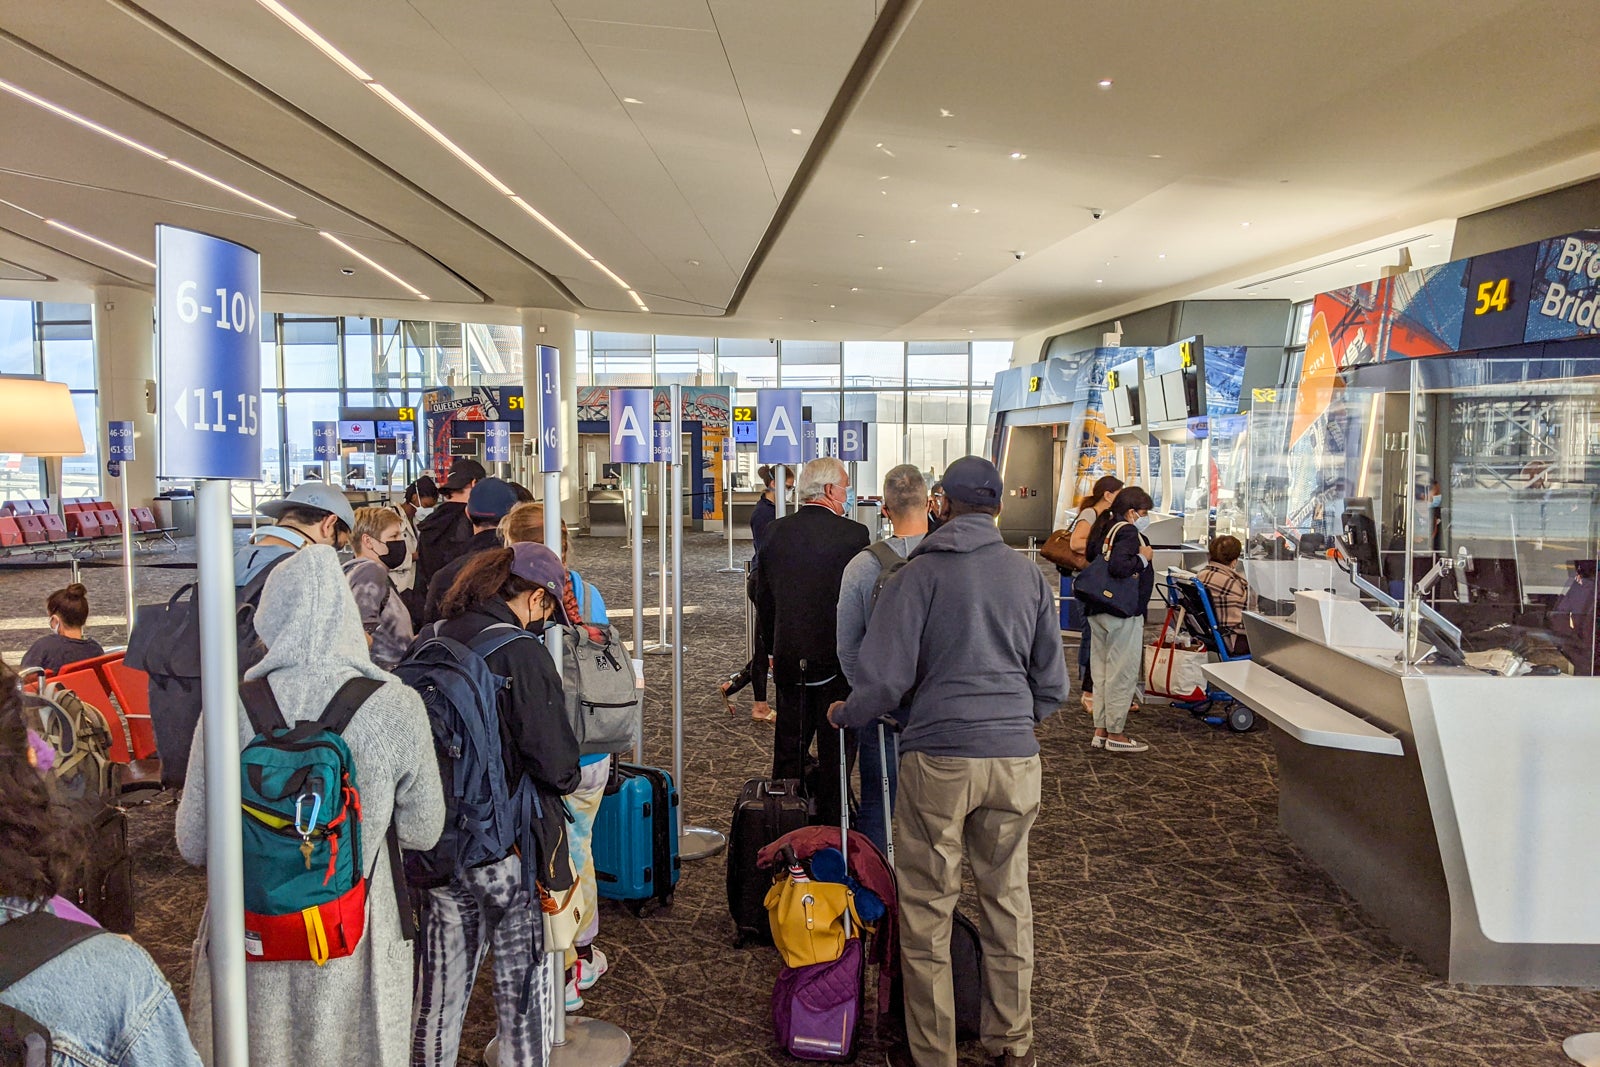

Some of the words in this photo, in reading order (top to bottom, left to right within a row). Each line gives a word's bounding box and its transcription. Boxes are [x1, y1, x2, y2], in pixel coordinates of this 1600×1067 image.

[1474, 278, 1509, 316] 54
[176, 280, 246, 333] 6-10
[433, 400, 463, 412] QUEENS
[509, 397, 524, 409] 51
[193, 388, 258, 436] 11-15
[399, 408, 415, 420] 51
[734, 408, 751, 421] 52
[614, 405, 646, 445] A
[763, 405, 799, 446] A
[110, 429, 128, 437] 46-50
[486, 429, 504, 437] 36-40
[843, 429, 859, 451] B
[111, 445, 132, 454] 51-55
